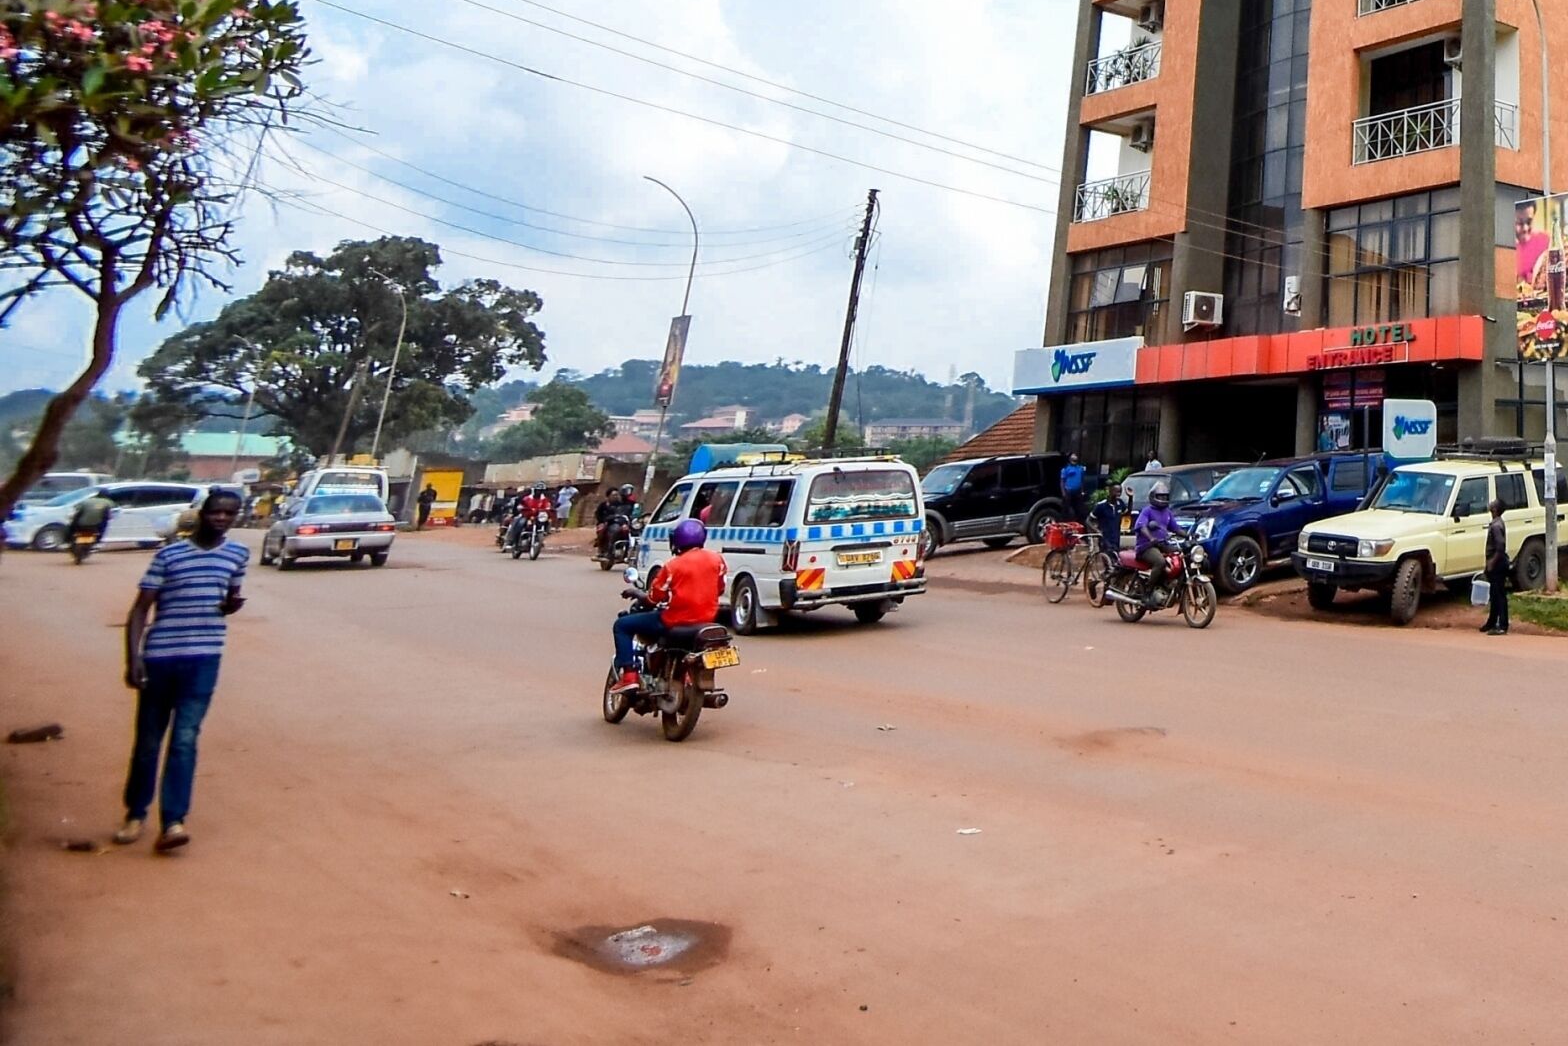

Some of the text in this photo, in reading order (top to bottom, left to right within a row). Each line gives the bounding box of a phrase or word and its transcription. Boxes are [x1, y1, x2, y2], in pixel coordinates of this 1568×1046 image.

[1351, 324, 1416, 346] HOTEL
[1060, 352, 1097, 375] NSSF
[1306, 346, 1393, 369] ENTRANCE
[1403, 420, 1433, 435] NSSF
